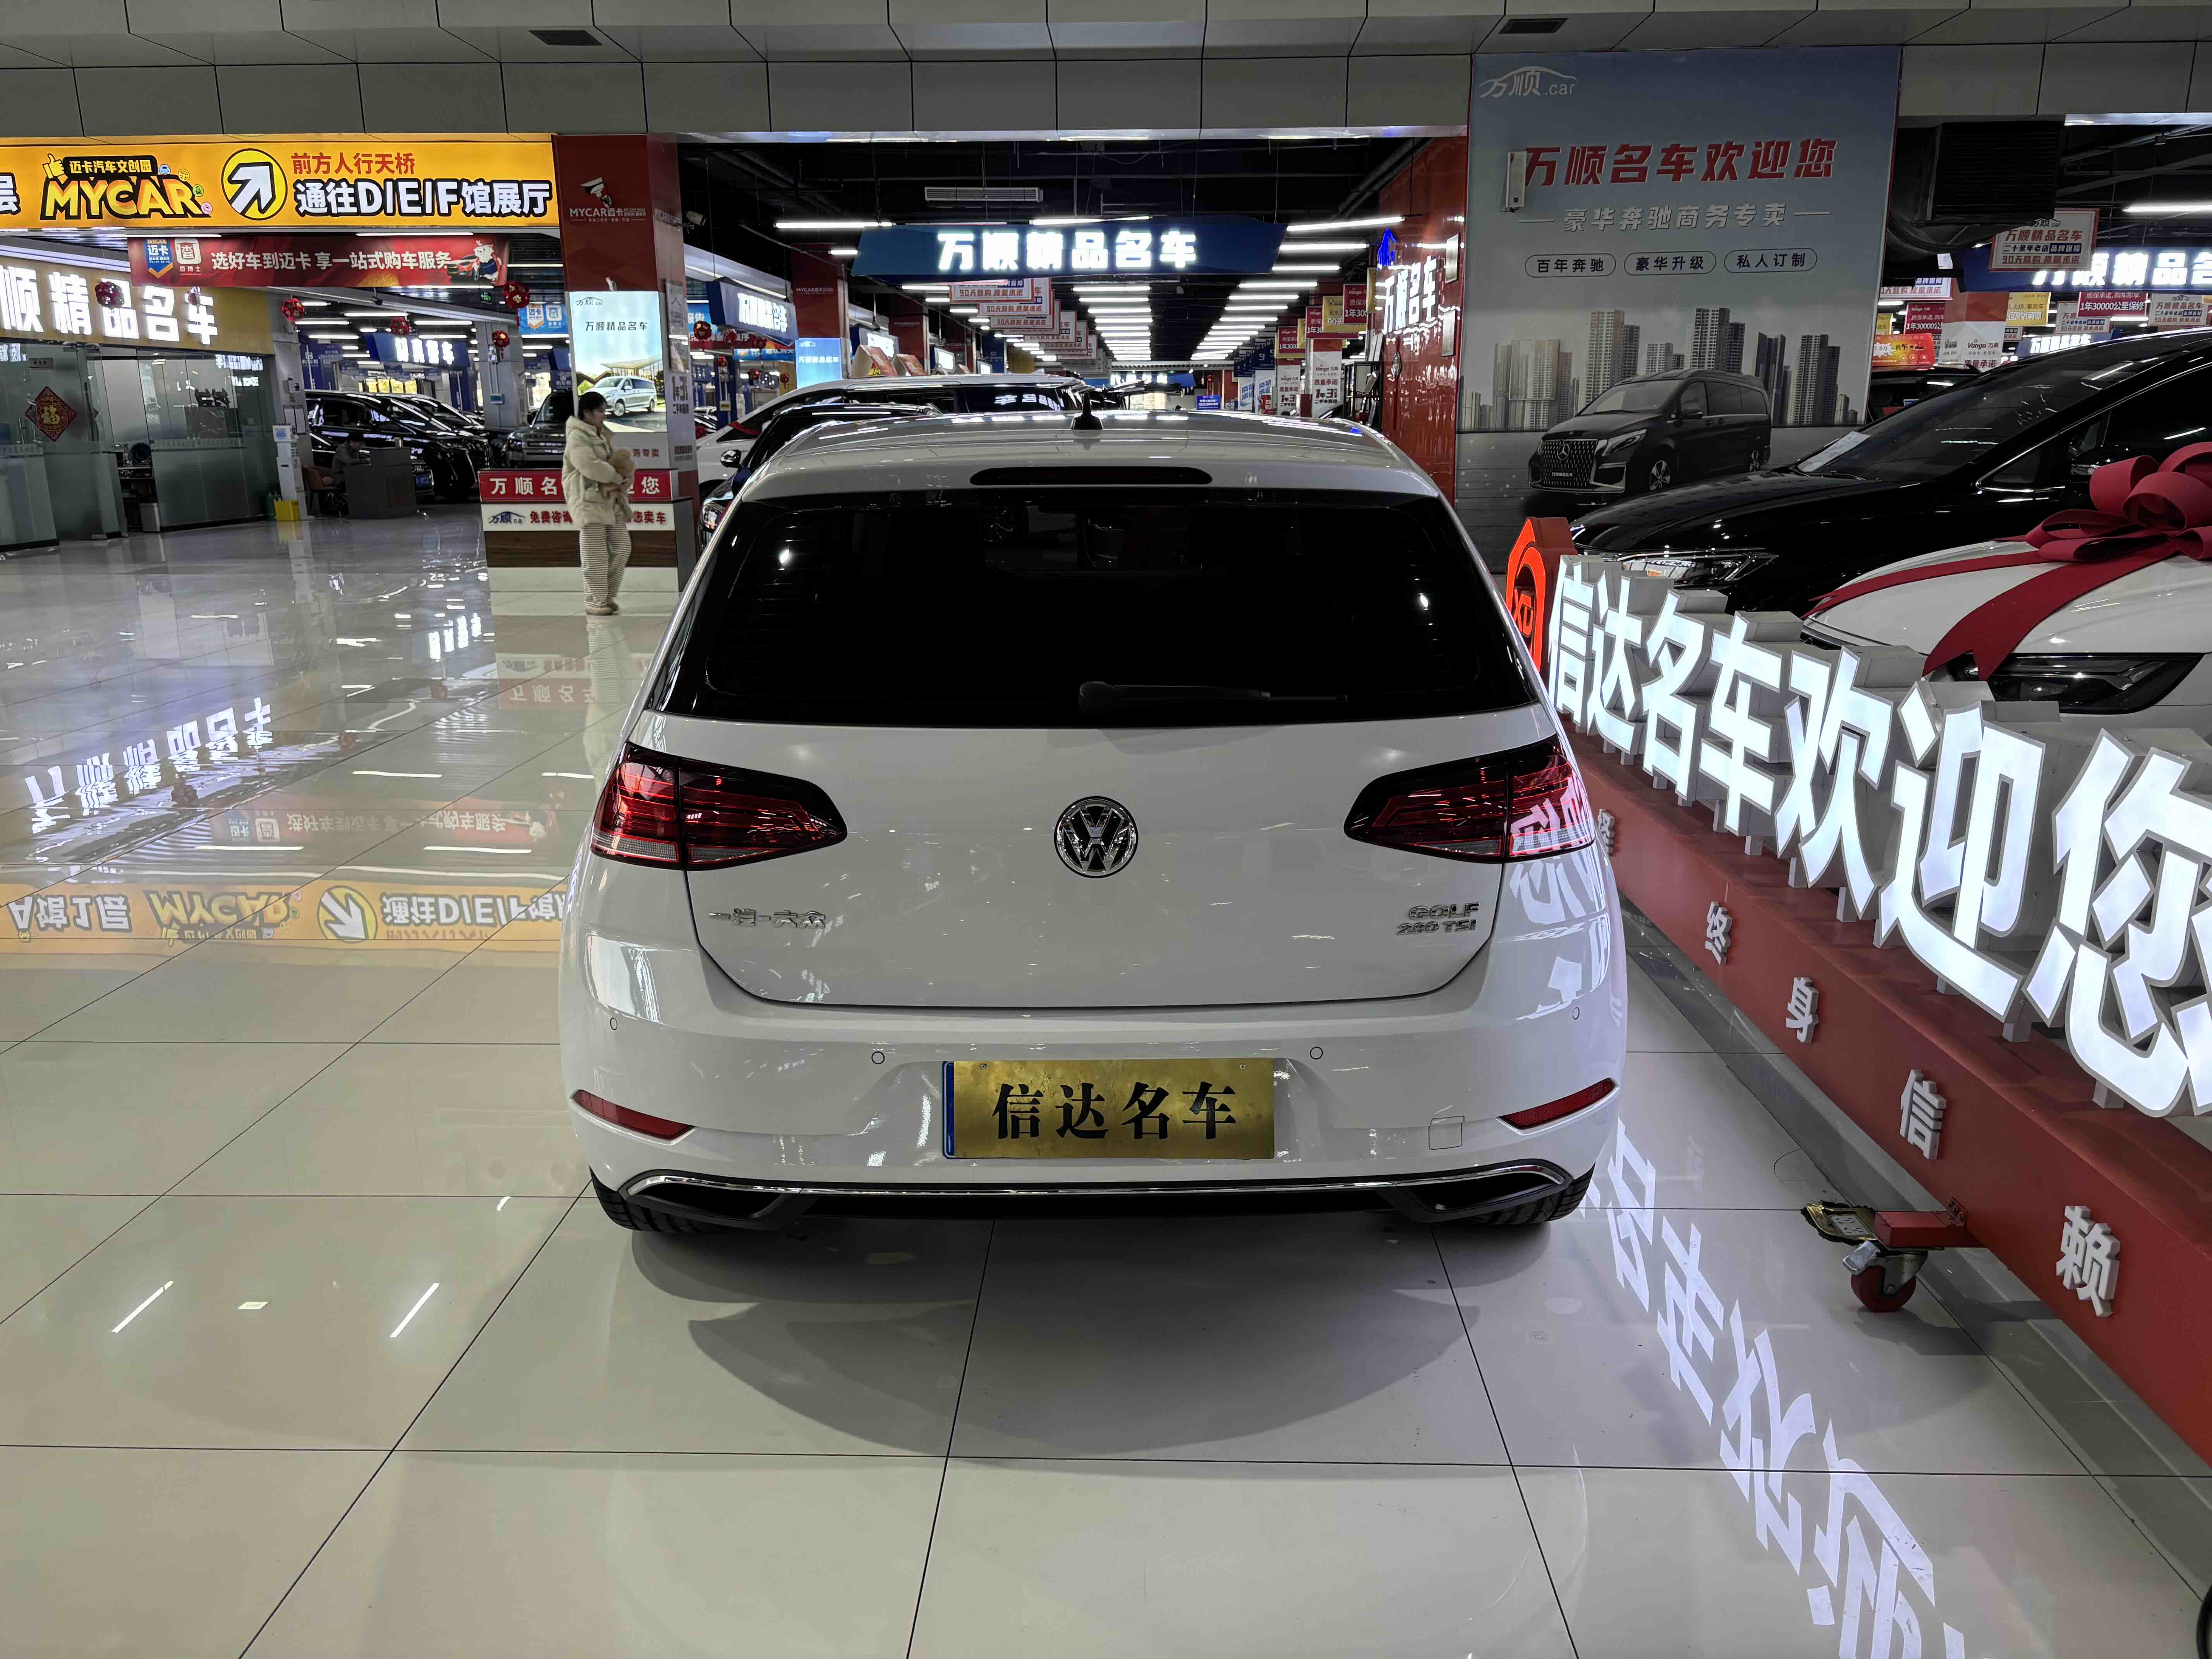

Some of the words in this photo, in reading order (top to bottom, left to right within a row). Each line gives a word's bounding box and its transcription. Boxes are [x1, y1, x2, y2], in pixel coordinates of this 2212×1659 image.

[69, 159, 152, 174] 迈卡汽车文创园
[291, 153, 416, 175] 前方人行天桥
[1524, 139, 1838, 186] 万顺名车欢迎您
[43, 179, 205, 217] MYCAR
[1563, 203, 1788, 232] 豪华奔驰商务专卖
[2005, 230, 2082, 241] 万顺精品名车
[148, 244, 168, 256] 迈卡
[937, 232, 1196, 269] 万顺精品名车
[211, 251, 311, 270] 选好车到迈卡
[316, 251, 452, 270] 享一站式购车服务
[1537, 258, 1604, 273] 百年奔驰
[1636, 256, 1704, 271] 豪华升级
[1736, 252, 1806, 268] 私人订制
[2081, 301, 2145, 311] 1年30000公里保修
[586, 321, 648, 331] 万顺精品名车
[1549, 555, 2212, 1118] 信达名车欢迎您
[1409, 902, 1479, 920] GOLF
[1396, 921, 1440, 936] 280
[1442, 919, 1477, 933] TSI
[992, 1081, 1237, 1140] 信达名车
